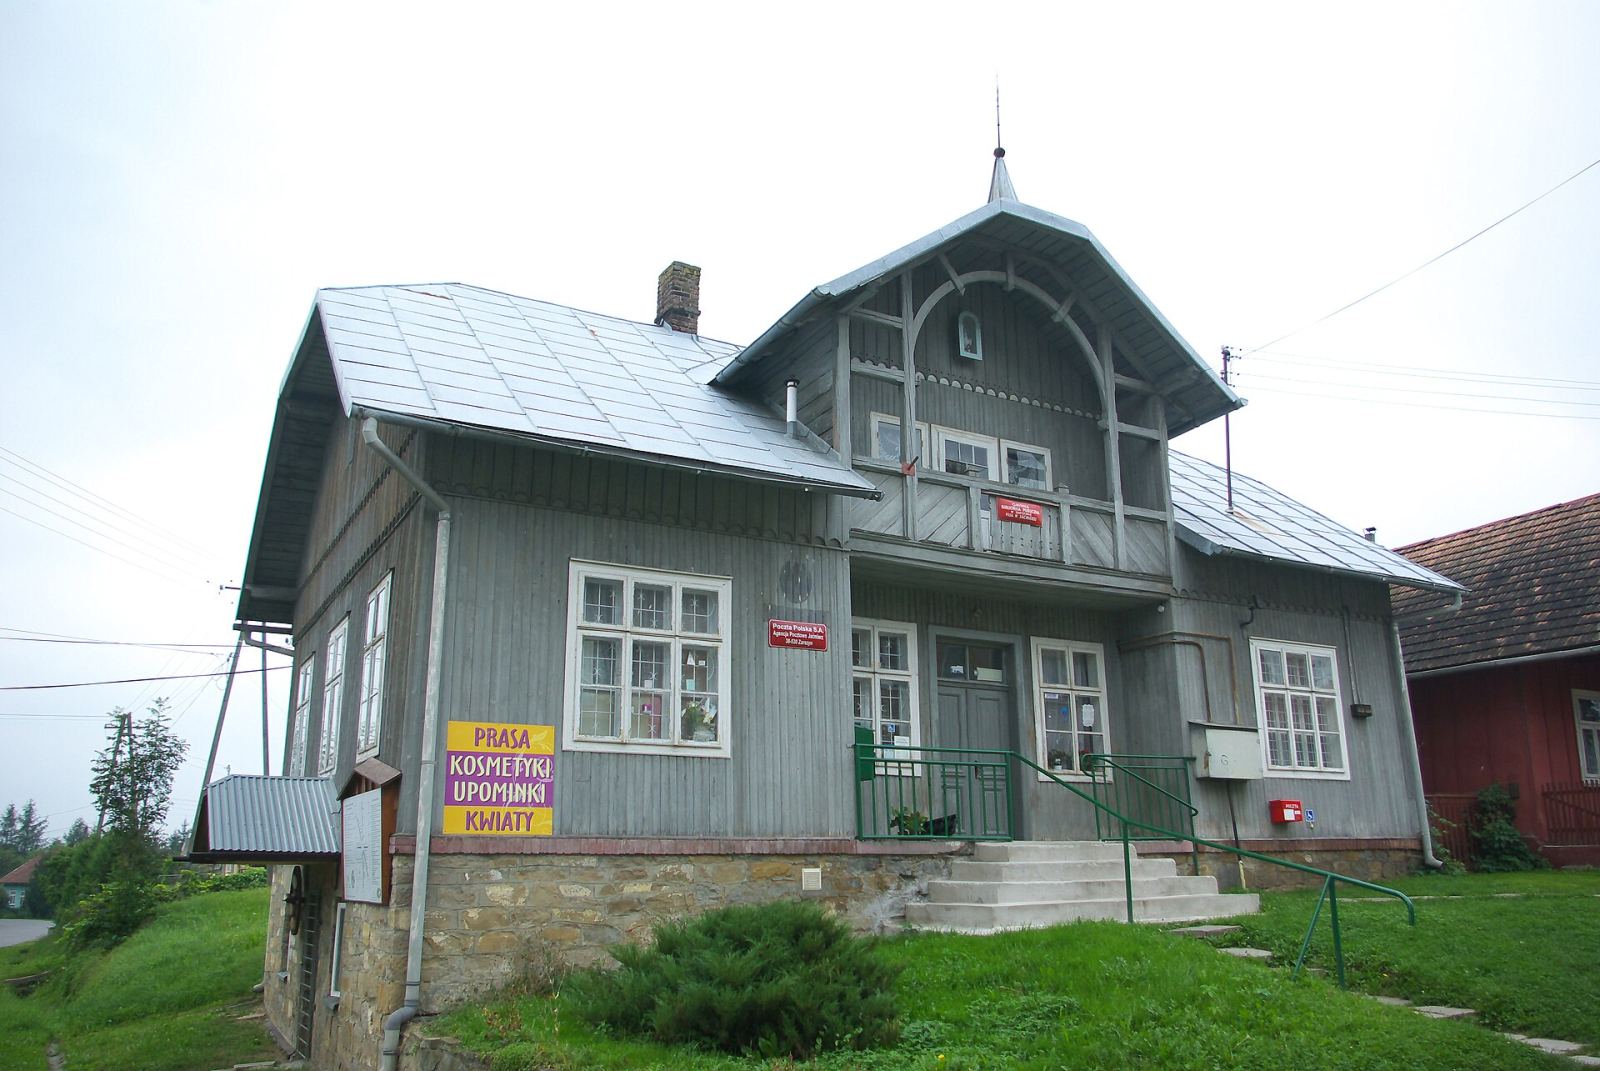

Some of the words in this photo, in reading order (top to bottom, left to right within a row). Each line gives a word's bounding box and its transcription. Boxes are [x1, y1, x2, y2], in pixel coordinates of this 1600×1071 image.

[474, 727, 531, 749] PRASA
[450, 755, 551, 778] KOSMETYKI
[454, 781, 546, 803] UPOMINKI
[465, 811, 534, 831] KWIATY
